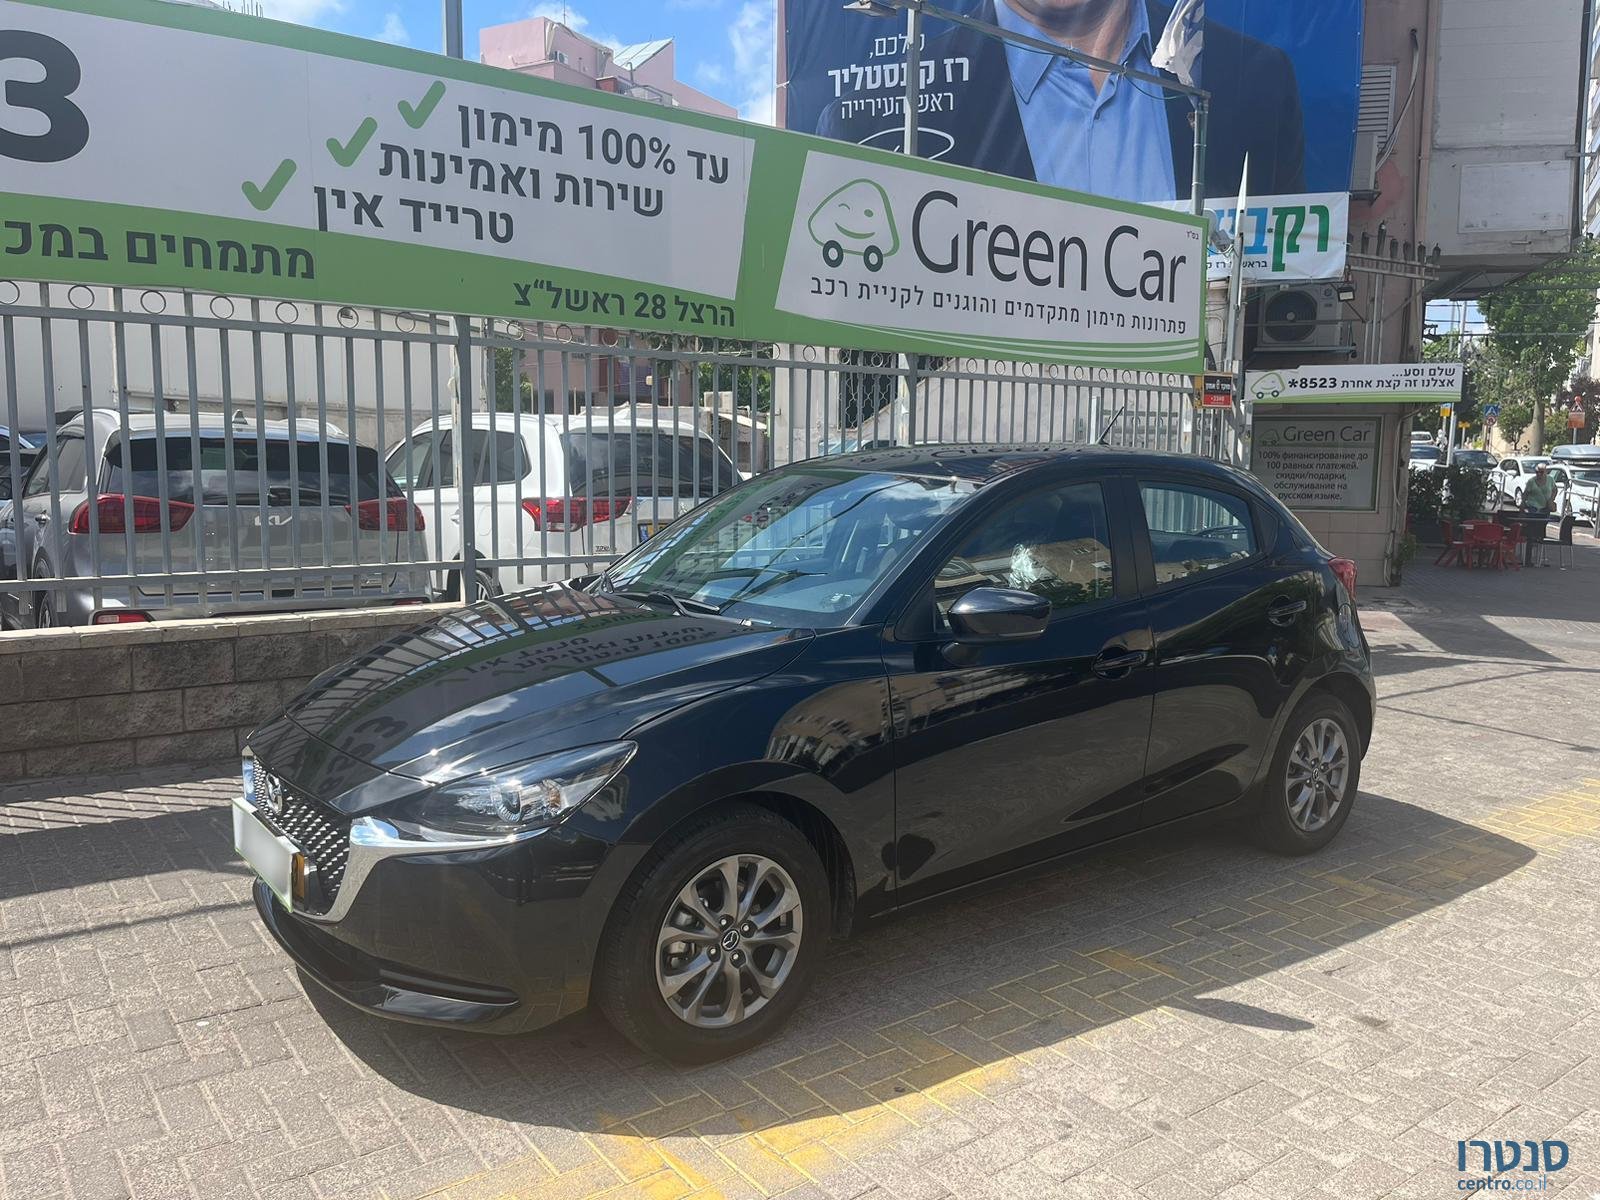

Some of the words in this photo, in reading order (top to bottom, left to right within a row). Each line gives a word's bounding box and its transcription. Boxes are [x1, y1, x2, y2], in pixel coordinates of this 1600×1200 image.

[827, 59, 936, 97] קנסטליך
[943, 57, 970, 83] רז
[458, 104, 563, 156] מימון
[578, 125, 676, 175] 100%
[379, 143, 541, 199] ואמינות
[687, 150, 729, 184] עד
[554, 171, 664, 217] שירות
[314, 186, 384, 232] אין
[399, 198, 514, 244] טרייד
[126, 230, 315, 279] מתמחים
[912, 189, 1088, 292] Green
[1104, 225, 1187, 303] Car
[810, 276, 850, 299] רכב
[857, 279, 925, 309] לקניית
[634, 291, 666, 320] 28
[674, 295, 735, 327] הרצל
[933, 292, 998, 315] והוגנים
[1004, 300, 1080, 325] מתקדמים
[1085, 309, 1126, 329] מימון
[1131, 315, 1187, 335] פתרונות
[1341, 379, 1372, 389] אחרת
[1376, 379, 1401, 390] קצת
[1404, 378, 1418, 388] זה
[1421, 377, 1455, 388] אצלנו
[1429, 366, 1456, 377] שלם
[1283, 426, 1335, 442] Green
[1340, 426, 1371, 442] Car
[1266, 461, 1280, 469] 100
